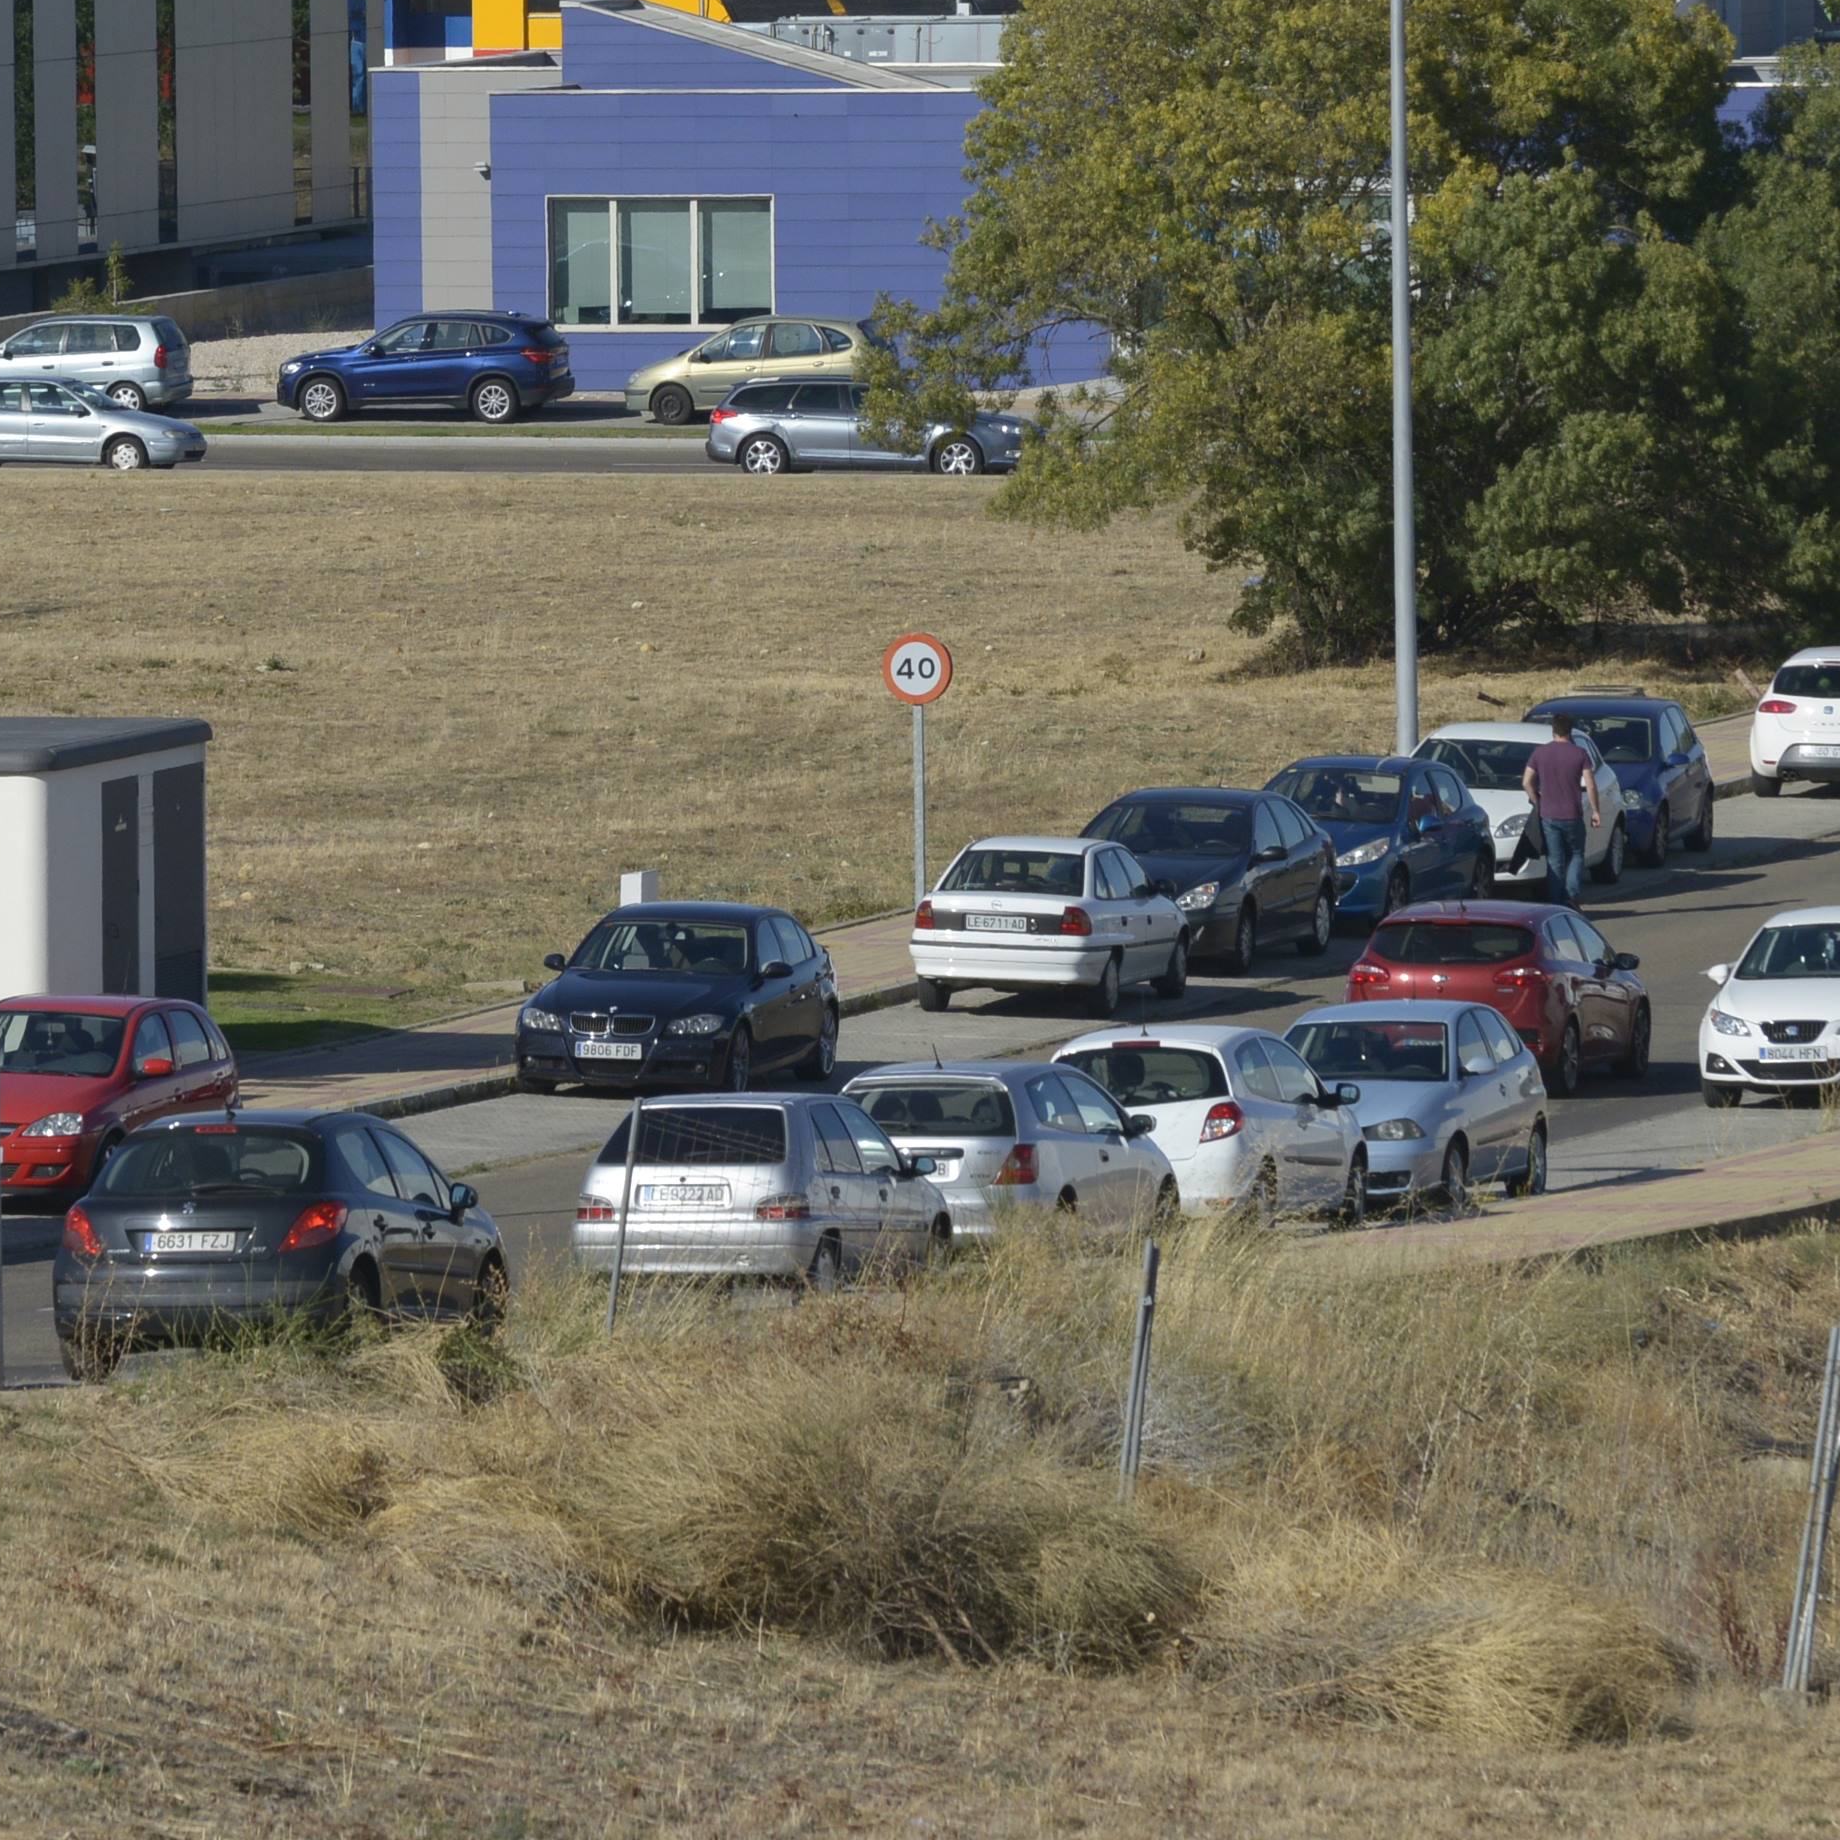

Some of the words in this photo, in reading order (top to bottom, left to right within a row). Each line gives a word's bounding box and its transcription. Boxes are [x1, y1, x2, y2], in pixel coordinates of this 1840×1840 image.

[896, 657, 935, 680] 40
[582, 1044, 612, 1056] 9806
[615, 1045, 637, 1057] FDF
[157, 1236, 193, 1249] 6631
[200, 1235, 229, 1252] FZJ
